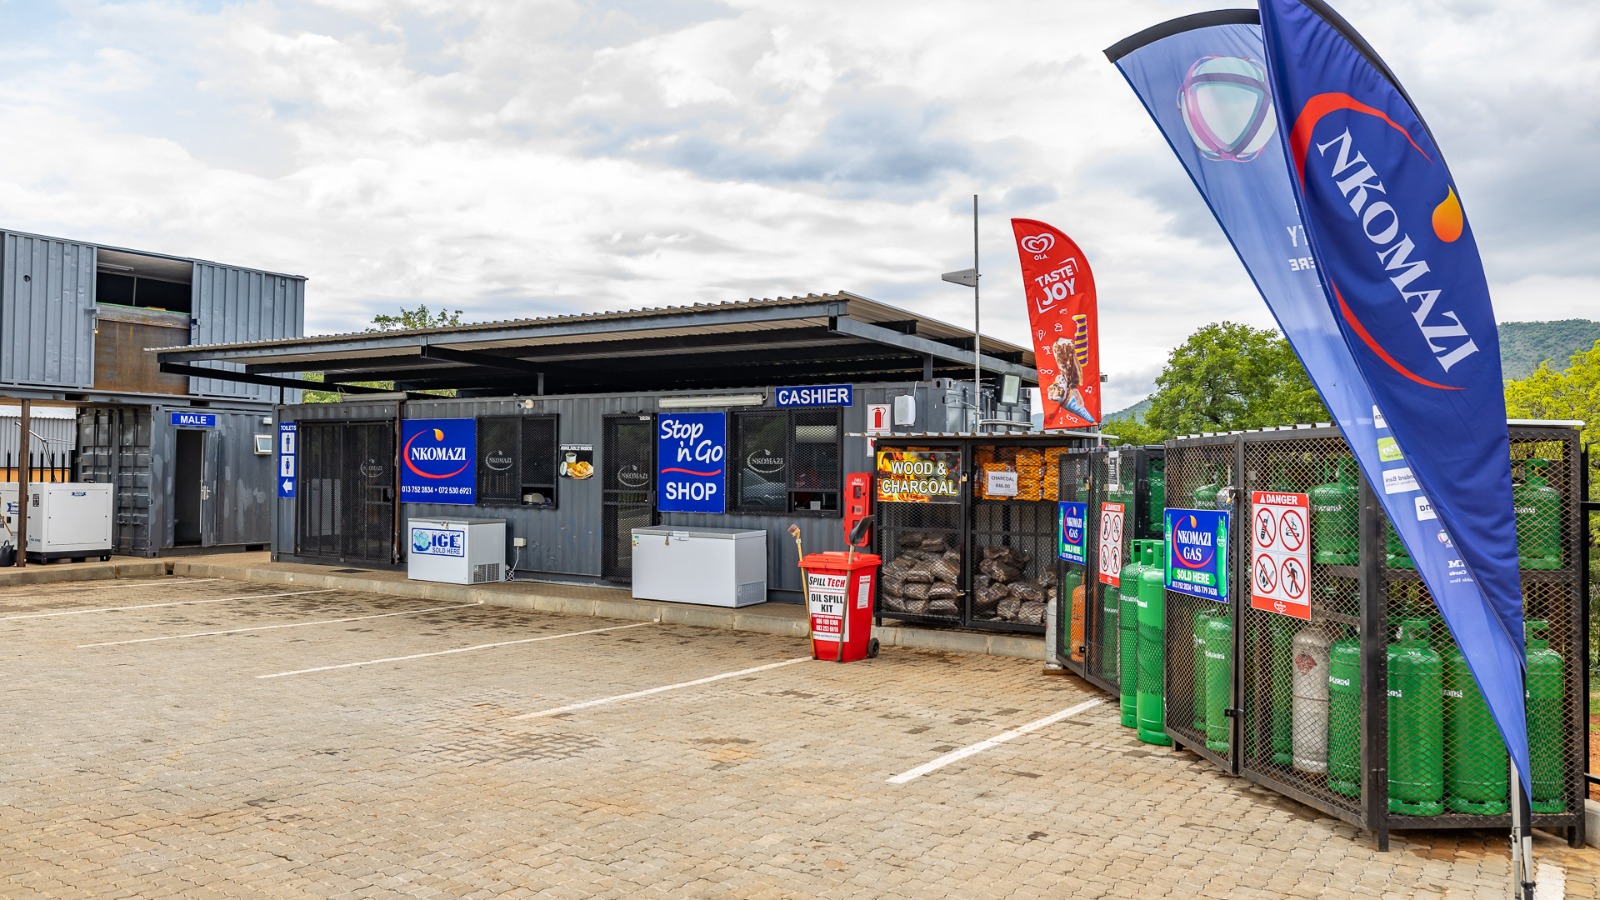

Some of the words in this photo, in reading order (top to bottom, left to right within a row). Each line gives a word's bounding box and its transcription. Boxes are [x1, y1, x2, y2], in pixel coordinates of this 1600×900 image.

[1316, 126, 1480, 373] NKOMAZI
[1035, 264, 1074, 288] TASTE
[1041, 278, 1075, 306] JOY
[778, 388, 849, 405] CASHIER
[180, 415, 207, 424] MALE
[660, 420, 704, 446] Stop
[411, 447, 466, 460] NKOMAZI
[695, 440, 723, 464] Go
[891, 461, 934, 475] WOOD
[937, 461, 947, 475] &
[438, 486, 448, 494] 072
[459, 487, 472, 495] 6921
[665, 482, 717, 501] SHOP
[881, 480, 957, 495] CHARCOAL
[1265, 494, 1298, 505] DANGER
[432, 531, 460, 548] ICE
[1069, 528, 1078, 539] GAS
[1177, 530, 1212, 546] NKOMAZI
[1183, 547, 1202, 561] GAS
[809, 576, 826, 587] SPILL
[827, 577, 845, 588] TECH
[1176, 569, 1192, 580] SOLD
[1192, 572, 1210, 584] HERE
[811, 593, 822, 602] OIL
[823, 594, 844, 604] SPILL
[820, 603, 833, 613] KIT
